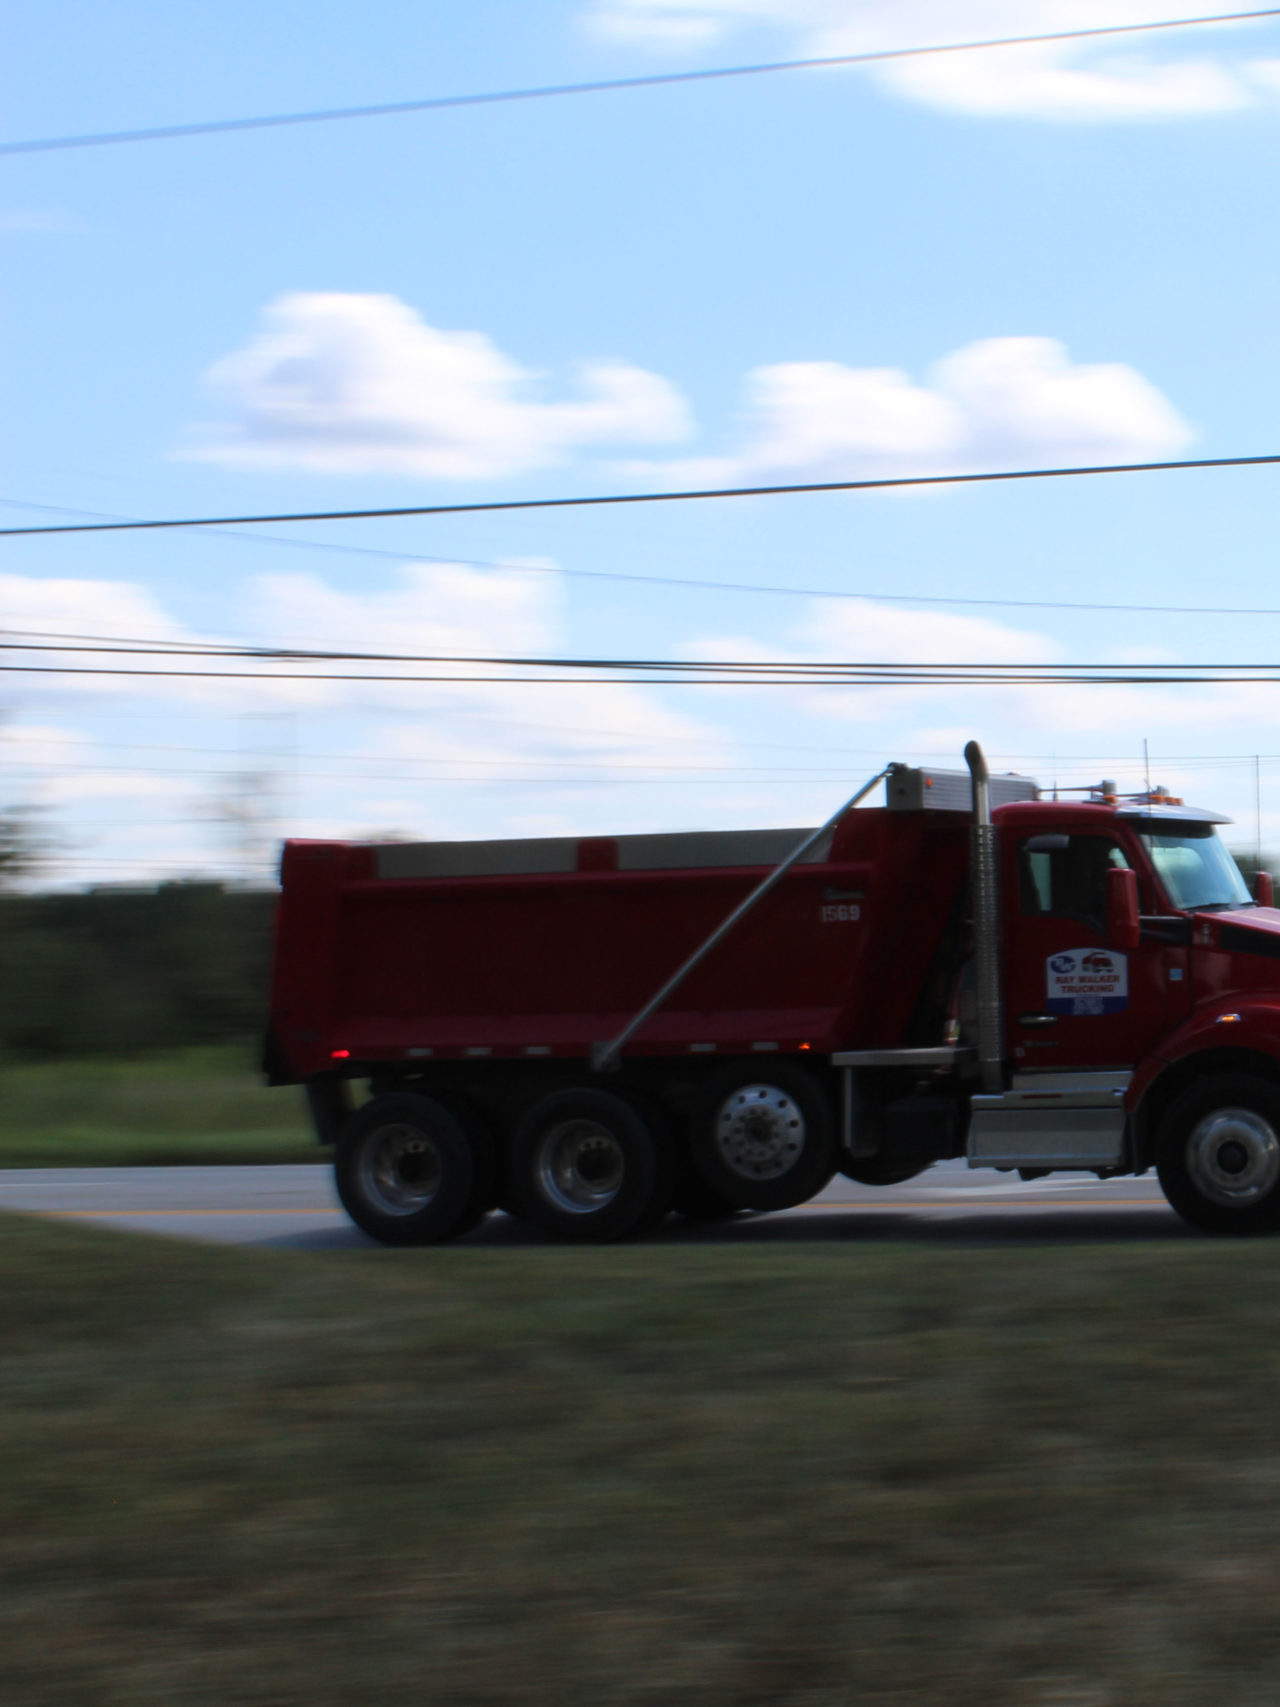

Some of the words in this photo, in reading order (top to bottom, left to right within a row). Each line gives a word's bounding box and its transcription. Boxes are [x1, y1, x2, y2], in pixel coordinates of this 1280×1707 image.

[820, 904, 860, 922] 1569
[1055, 976, 1075, 985] RAY
[1078, 974, 1121, 984] WALKER
[1061, 984, 1115, 994] TRUCKING
